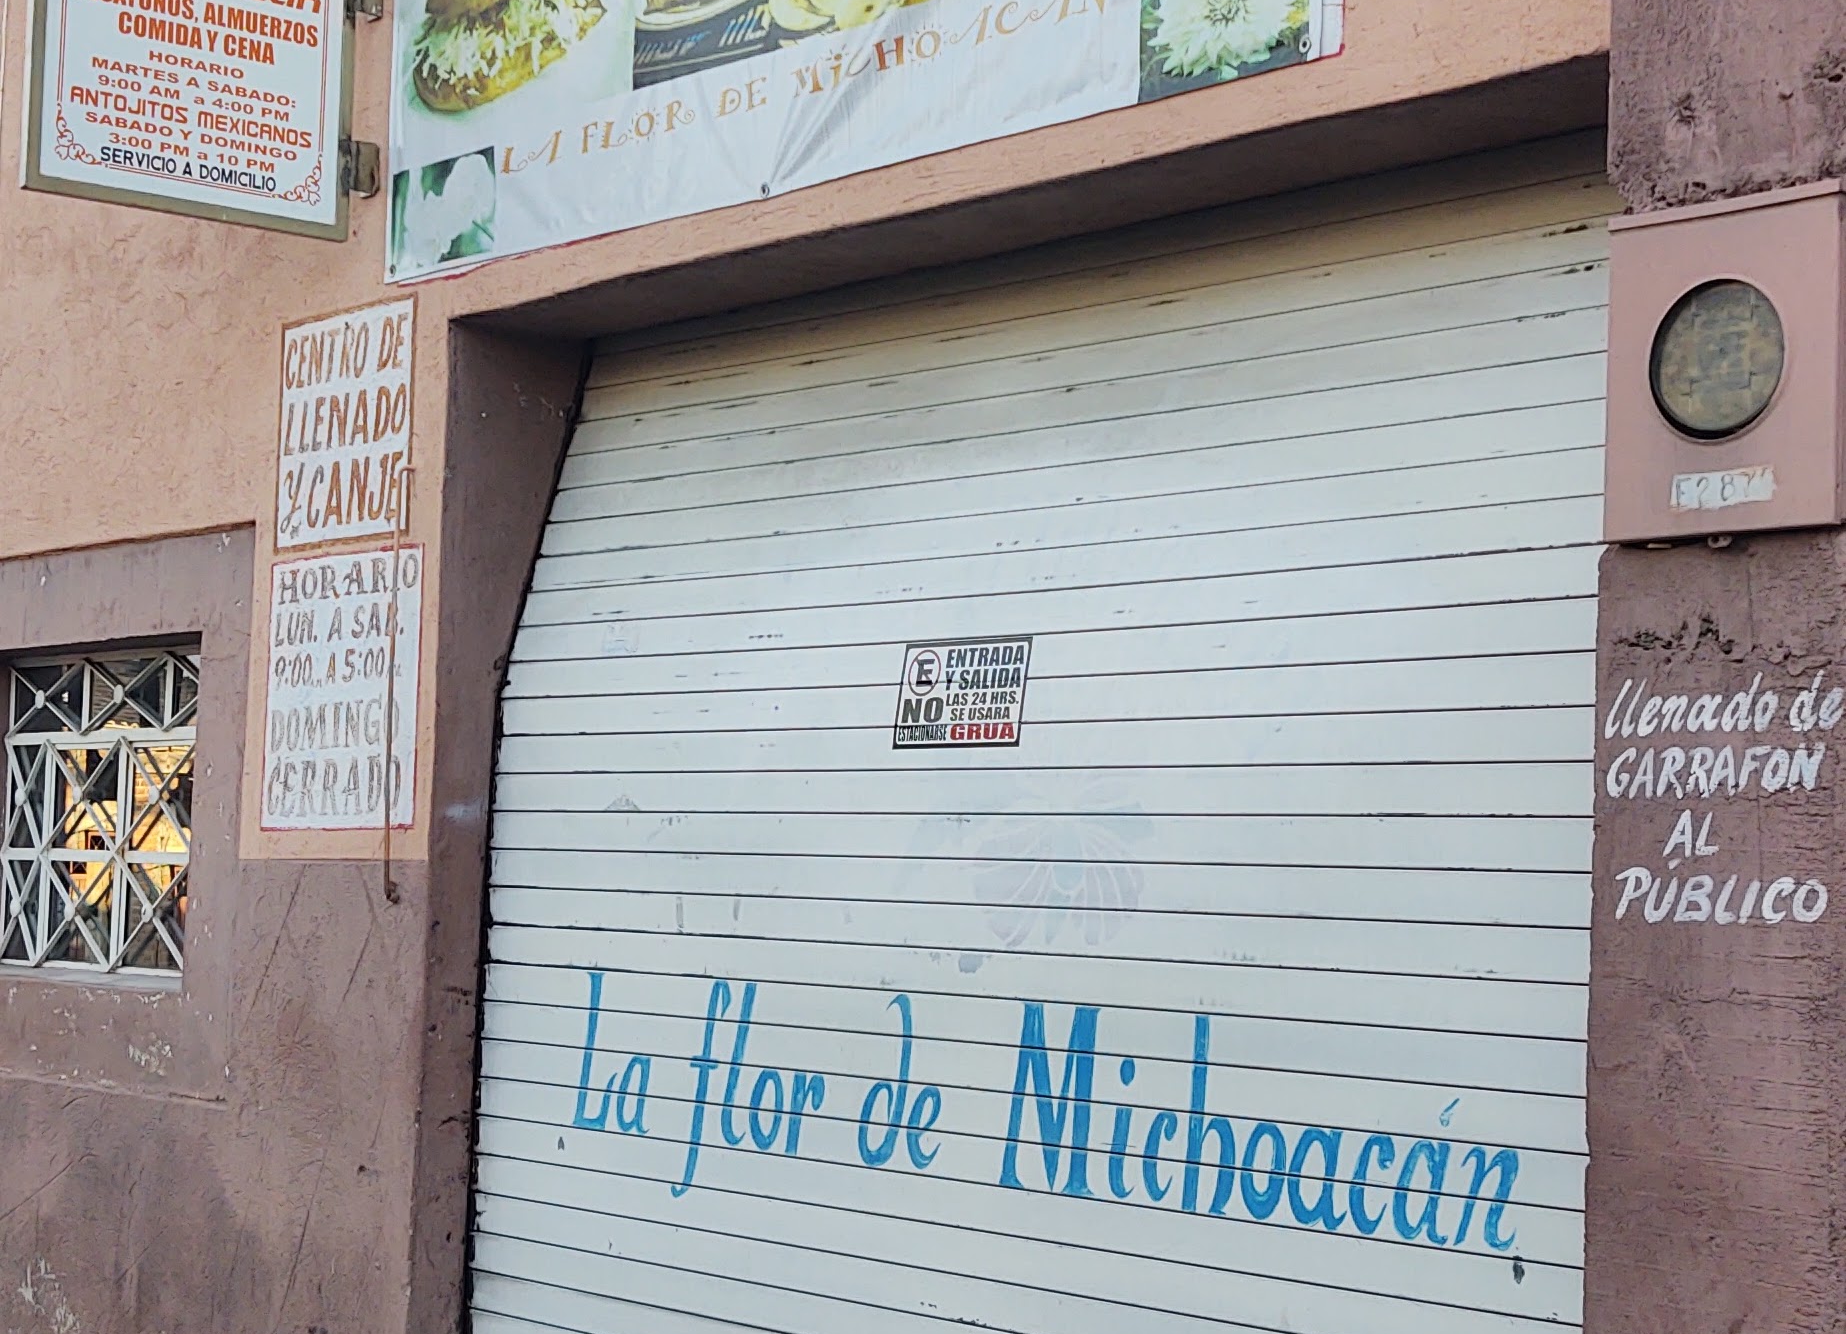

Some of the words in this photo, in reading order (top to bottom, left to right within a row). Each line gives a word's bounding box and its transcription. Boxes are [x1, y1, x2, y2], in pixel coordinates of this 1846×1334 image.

[118, 11, 201, 50] COMIDA
[206, 30, 219, 52] Y
[223, 34, 275, 65] CENA
[204, 2, 318, 48] ALMUERZOS
[92, 57, 180, 84] MARTES
[186, 75, 201, 88] A
[207, 81, 297, 108] SABADO:
[149, 50, 244, 80] HORARIO
[70, 86, 189, 124] ANTOJITOS
[98, 74, 142, 92] 9:00
[148, 86, 181, 100] AM
[193, 95, 205, 105] a
[211, 97, 254, 115] 4:00
[261, 107, 290, 122] PM
[85, 111, 173, 138] SABADO
[179, 128, 192, 141] Y
[200, 132, 297, 161] DOMINGO
[500, 130, 562, 174] LA
[581, 99, 695, 154] FLOR
[716, 77, 767, 118] DE
[100, 146, 177, 174] SERVICIO
[183, 162, 193, 177] A
[199, 164, 277, 192] DOMICILIO
[108, 132, 152, 150] 3:00
[160, 142, 190, 158] PM
[197, 151, 208, 161] a
[217, 153, 239, 167] 10
[246, 158, 275, 173] PM
[285, 322, 369, 390] CENTRO
[377, 312, 410, 372] DE
[284, 383, 407, 456] LLENADO
[306, 451, 403, 529] CANJE
[278, 553, 419, 605] HORARO
[274, 610, 317, 647] LUN.
[327, 607, 342, 642] A
[327, 652, 336, 684] A
[945, 670, 956, 691] Y
[958, 667, 1021, 690] SALIDA
[946, 645, 1025, 668] ENTRADA
[901, 697, 944, 723] NO
[946, 692, 968, 706] LAS
[971, 692, 987, 706] 24
[990, 691, 1019, 705] HRS.
[950, 708, 965, 721] SE
[968, 707, 1010, 721] USARA
[1604, 671, 1779, 740] llenado
[1789, 669, 1844, 731] de
[898, 725, 947, 742] ESTACIONARSE
[950, 723, 1014, 740] GRUA
[1606, 742, 1826, 800] GARRAFON
[1662, 809, 1720, 858] AL
[572, 972, 650, 1134] La
[672, 979, 825, 1198] flor
[857, 993, 945, 1171] de
[999, 1001, 1520, 1253] Michoacán
